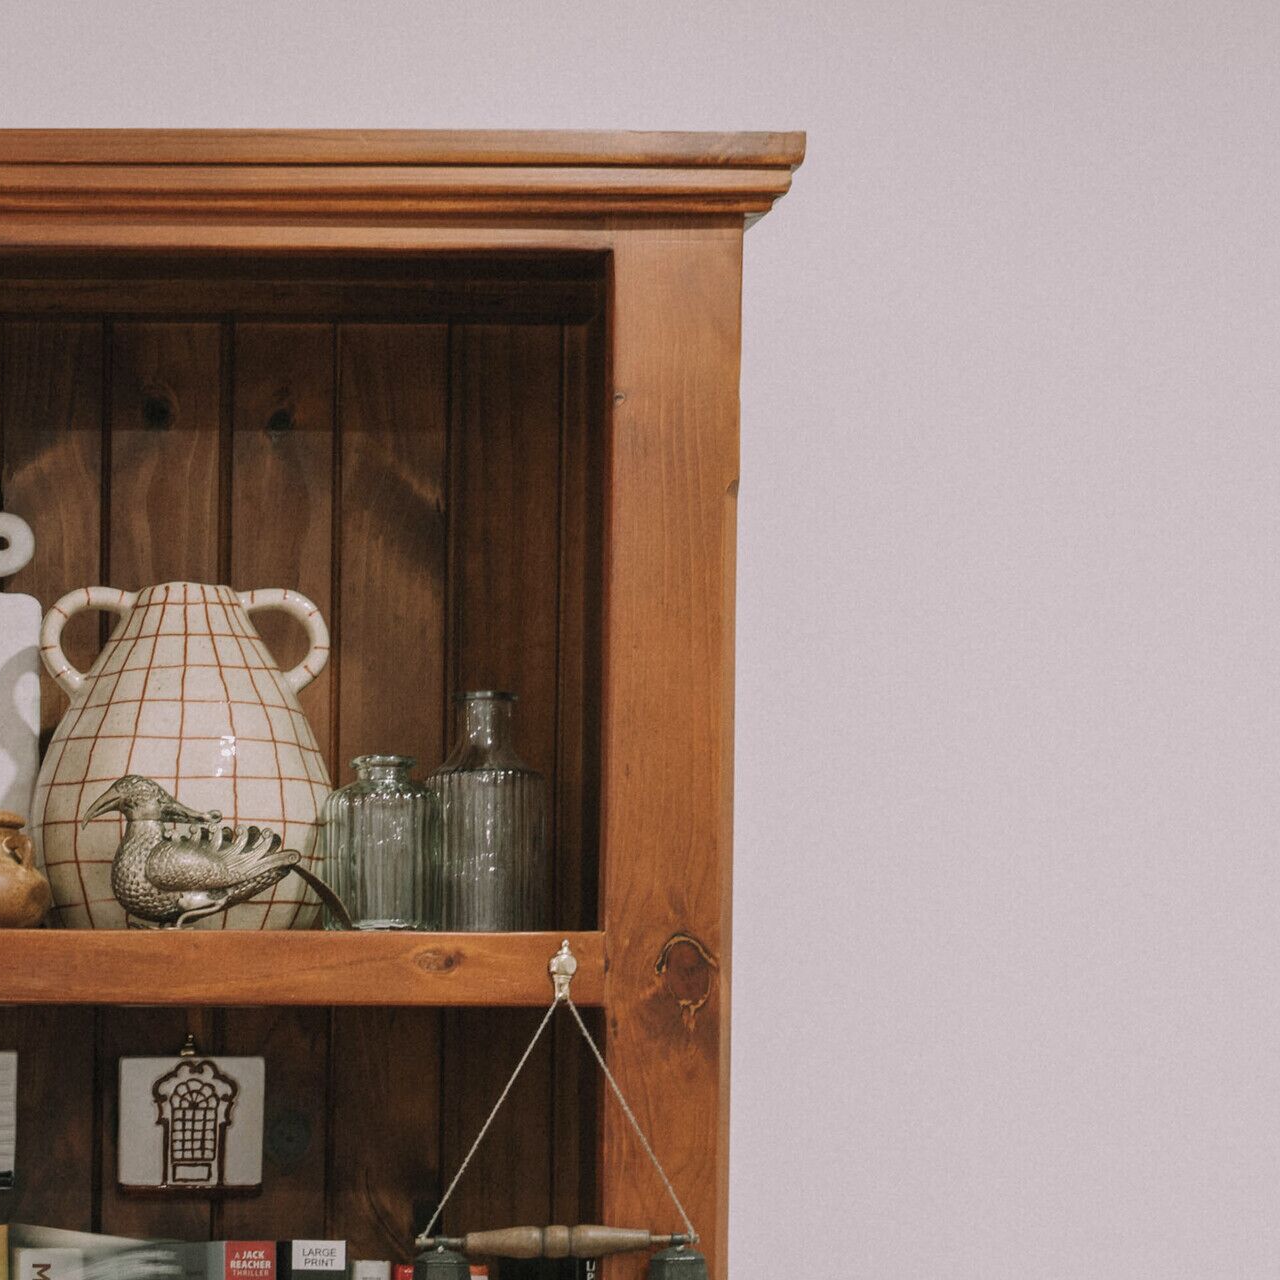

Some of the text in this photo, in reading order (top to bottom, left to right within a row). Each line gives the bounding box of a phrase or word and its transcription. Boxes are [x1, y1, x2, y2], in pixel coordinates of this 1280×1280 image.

[241, 1250, 265, 1259] JACK
[302, 1248, 337, 1257] LARGE
[230, 1260, 272, 1269] REACHER
[304, 1258, 335, 1267] PRINT
